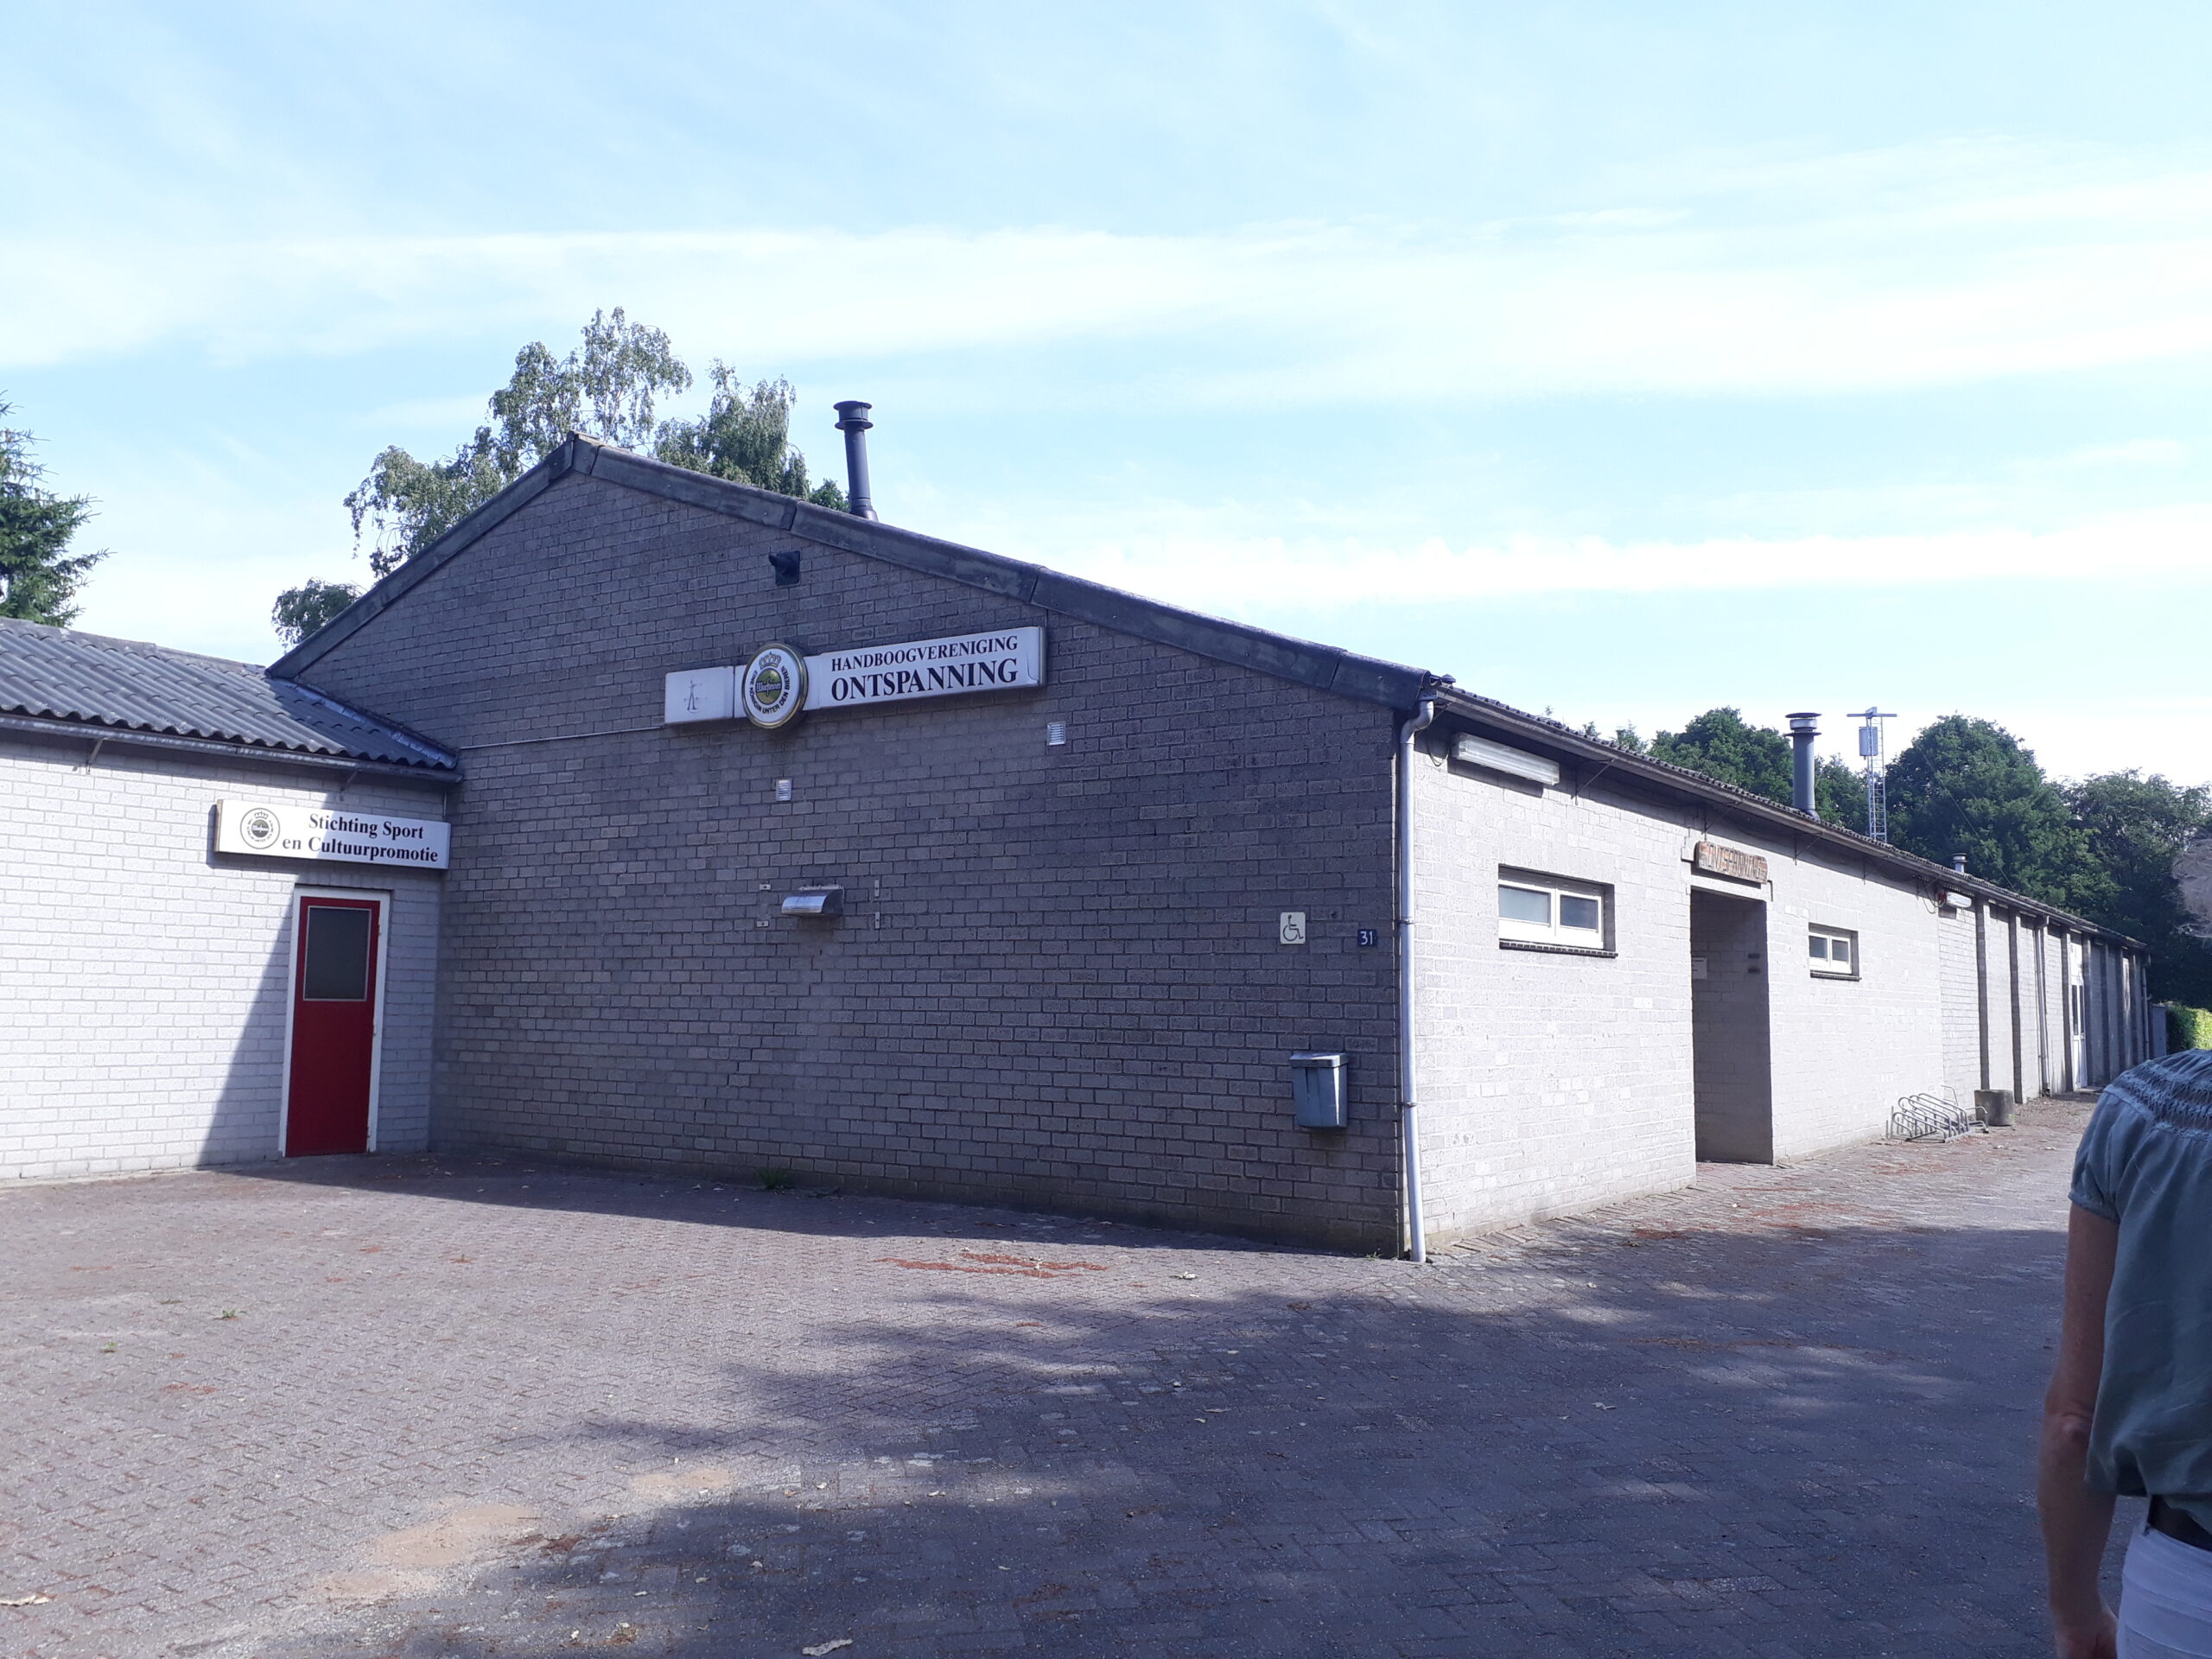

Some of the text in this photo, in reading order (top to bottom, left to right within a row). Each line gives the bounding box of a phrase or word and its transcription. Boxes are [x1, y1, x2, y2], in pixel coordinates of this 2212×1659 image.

[831, 635, 1018, 671] HANDBOOGVERENIGING
[831, 657, 1018, 702] ONTSPANNING
[779, 691, 788, 706] DEN
[308, 812, 424, 840] Stichting Sport
[282, 836, 439, 862] en Cultuurpromotie
[1360, 931, 1373, 945] 31
